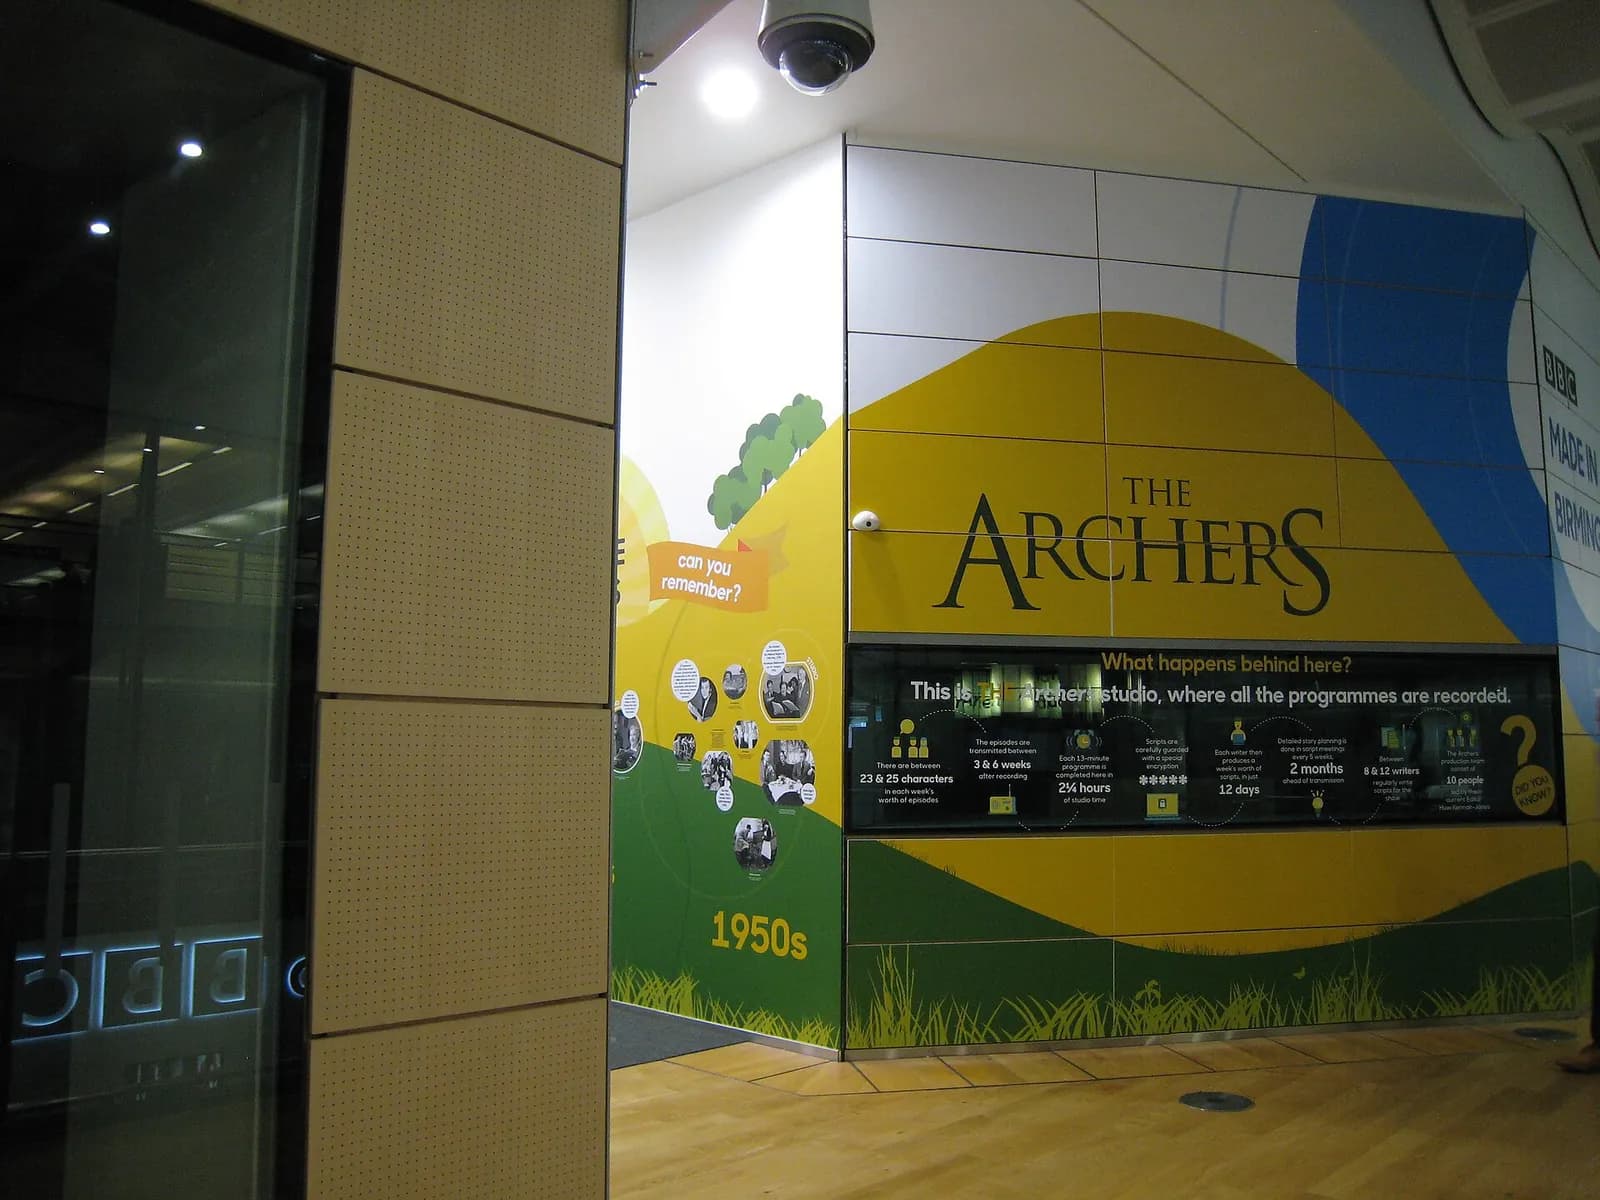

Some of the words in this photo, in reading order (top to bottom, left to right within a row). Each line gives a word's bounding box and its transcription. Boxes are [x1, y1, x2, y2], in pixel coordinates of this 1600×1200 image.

[1543, 345, 1578, 406] BBC
[1548, 416, 1584, 478] MADE
[1586, 443, 1598, 486] IN
[1122, 477, 1192, 507] THE
[931, 493, 1331, 616] ARCHERS
[678, 554, 703, 570] can
[706, 558, 732, 576] you
[661, 576, 742, 602] remember?
[1101, 652, 1154, 671] What
[1158, 653, 1236, 677] happens
[1241, 654, 1299, 673] behind
[1304, 655, 1352, 673] here?
[911, 681, 951, 700] This
[956, 683, 972, 701] is
[1101, 685, 1162, 704] studio,
[1167, 685, 1226, 703] where
[1230, 685, 1250, 703] all
[1255, 686, 1284, 704] the
[1288, 688, 1397, 709] programmes
[1402, 690, 1429, 704] are
[1434, 687, 1511, 704] recorded.
[989, 738, 1018, 747] episodes
[974, 760, 980, 769] 3
[982, 760, 991, 769] &
[992, 760, 999, 769] 6
[1001, 760, 1032, 769] weeks
[1290, 762, 1298, 774] 2
[1301, 762, 1344, 774] months
[1364, 766, 1370, 776] 8
[1370, 766, 1378, 776] &
[1380, 766, 1390, 776] 12
[1392, 766, 1420, 776] writers
[860, 774, 873, 784] 23
[875, 774, 884, 784] &
[886, 774, 899, 784] 25
[901, 774, 954, 784] characters
[996, 773, 1028, 781] recording
[1446, 776, 1457, 785] 10
[1458, 776, 1485, 787] people
[1079, 782, 1112, 793] hours
[1219, 784, 1233, 795] 12
[1235, 784, 1260, 798] days
[908, 796, 940, 806] episodes
[712, 910, 808, 960] 1950s
